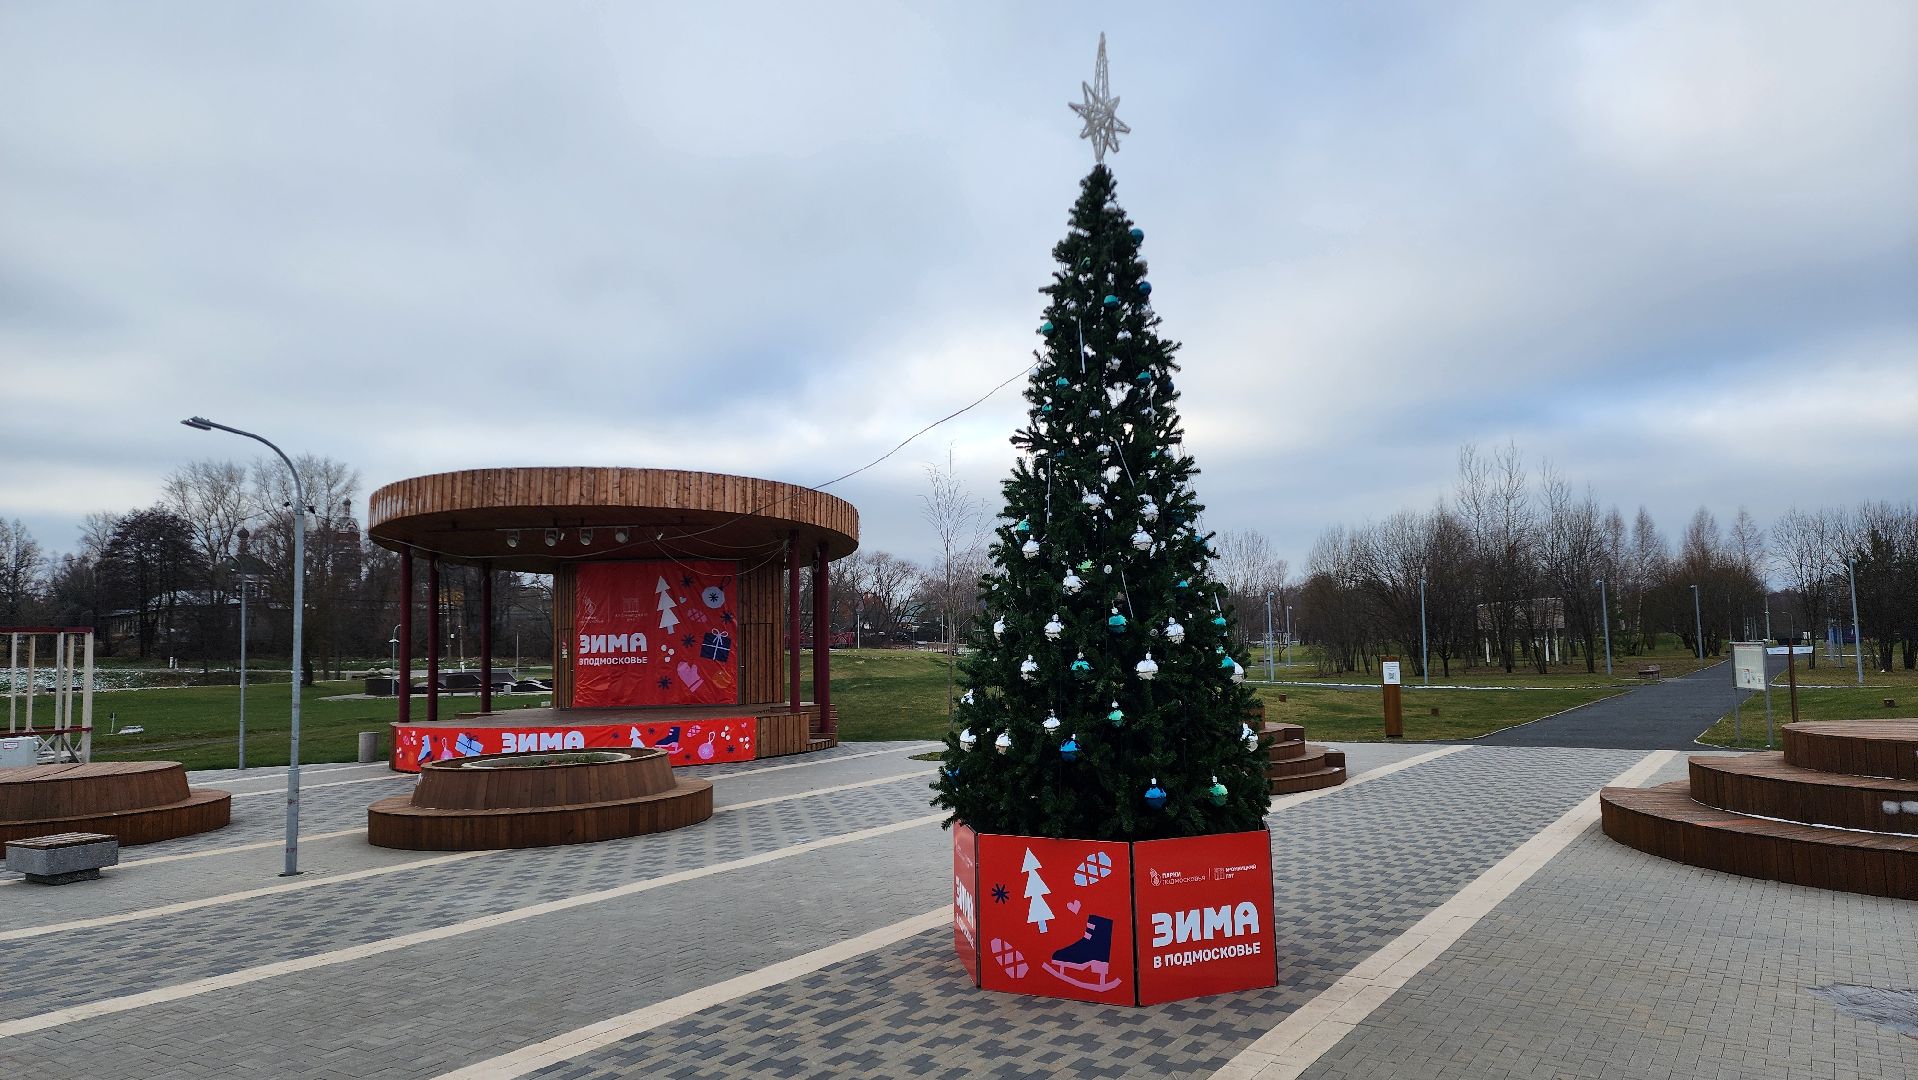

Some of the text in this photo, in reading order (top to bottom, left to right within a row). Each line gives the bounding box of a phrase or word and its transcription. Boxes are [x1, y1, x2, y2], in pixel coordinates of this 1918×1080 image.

[579, 632, 648, 654] ЗИМА
[501, 730, 585, 754] ЗИМА
[1151, 901, 1260, 948] ЗИМА
[1153, 942, 1261, 969] В ПОДМОСКОВЬЕ
